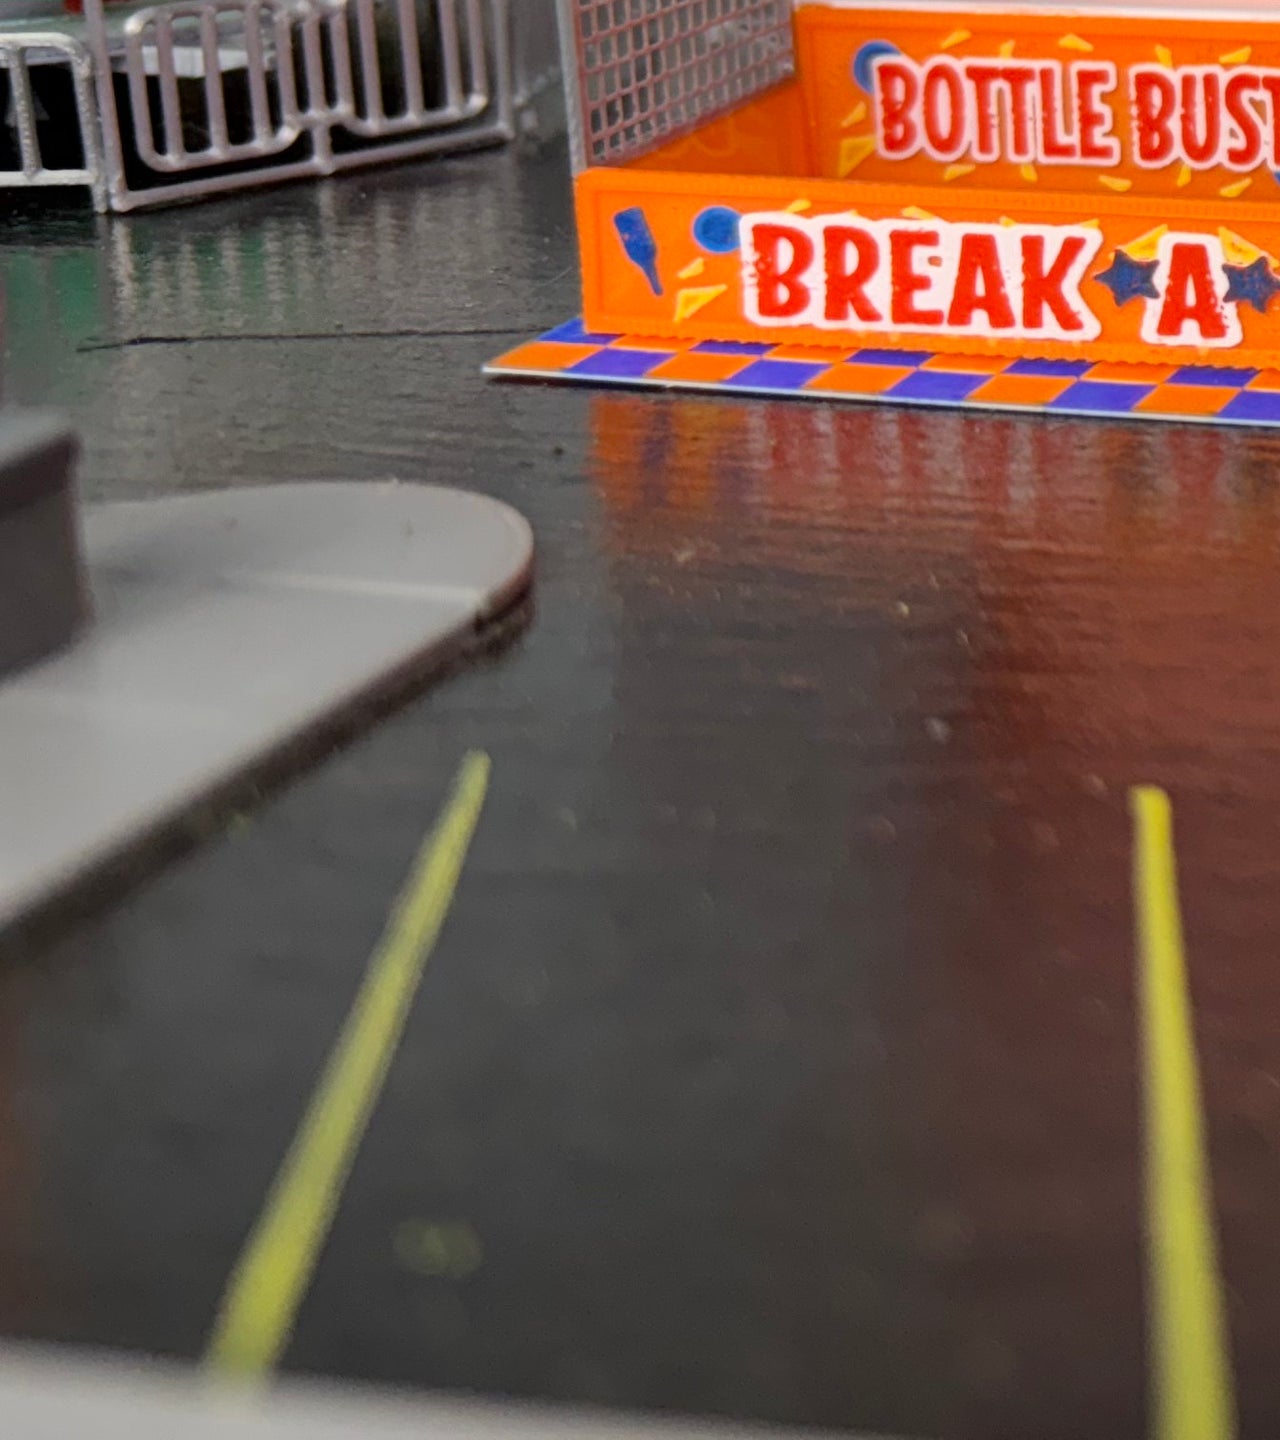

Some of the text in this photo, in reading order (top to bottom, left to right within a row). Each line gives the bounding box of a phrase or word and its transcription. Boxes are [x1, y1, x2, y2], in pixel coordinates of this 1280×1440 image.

[873, 59, 1117, 164] BOTTLE
[748, 220, 1090, 335] BREAK
[1152, 239, 1231, 343] A
